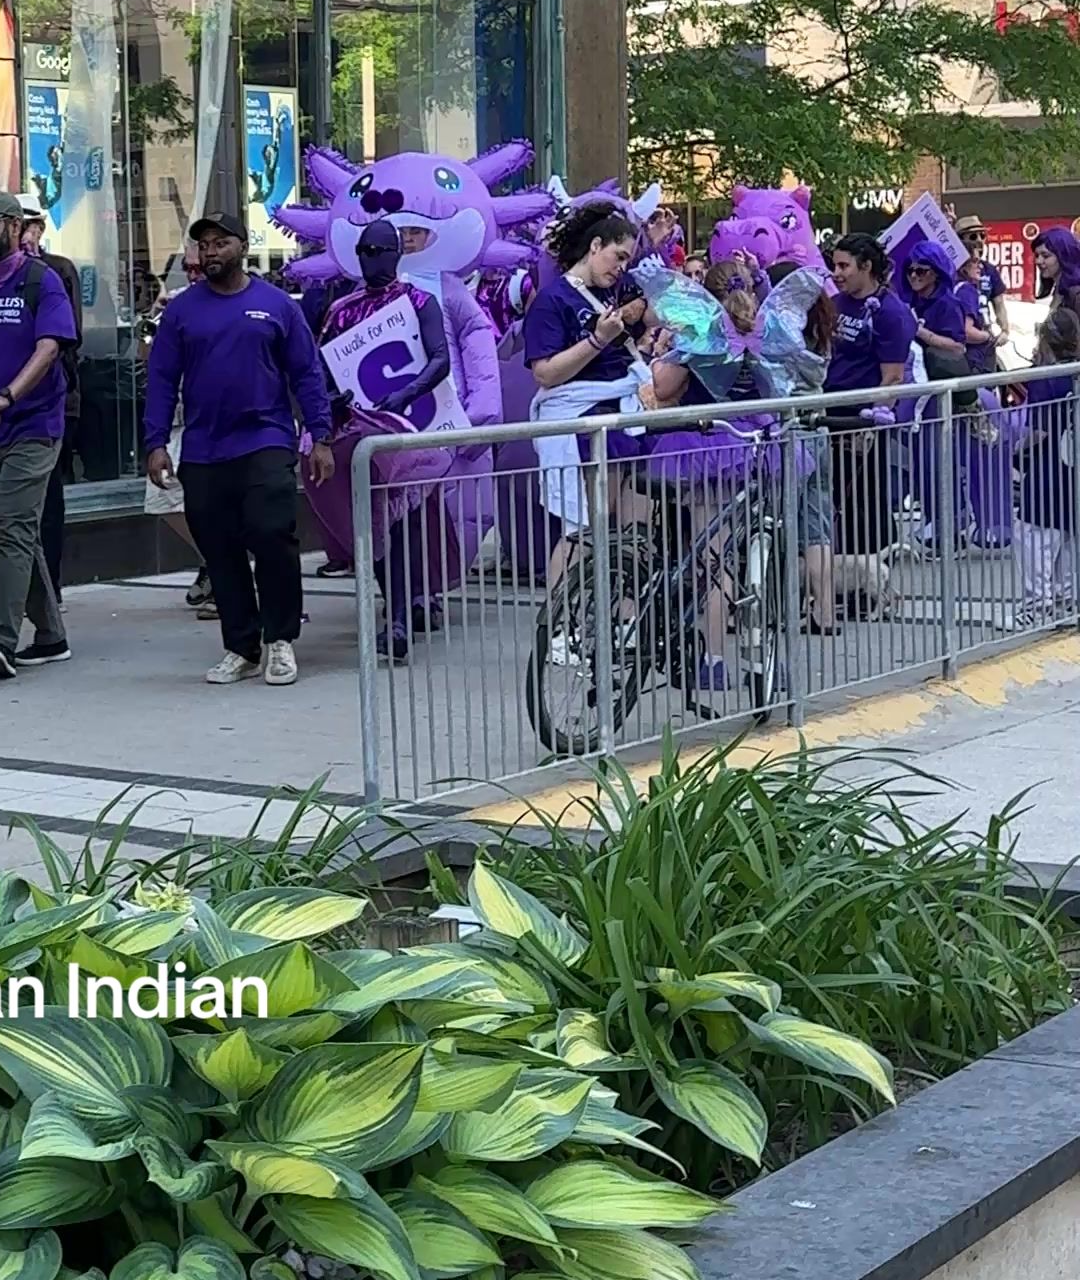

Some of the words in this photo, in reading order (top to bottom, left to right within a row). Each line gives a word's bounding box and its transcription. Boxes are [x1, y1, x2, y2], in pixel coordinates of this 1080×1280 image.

[249, 229, 267, 246] Bell
[333, 348, 341, 361] I
[342, 333, 367, 357] walk
[367, 322, 384, 340] for
[386, 311, 406, 328] my
